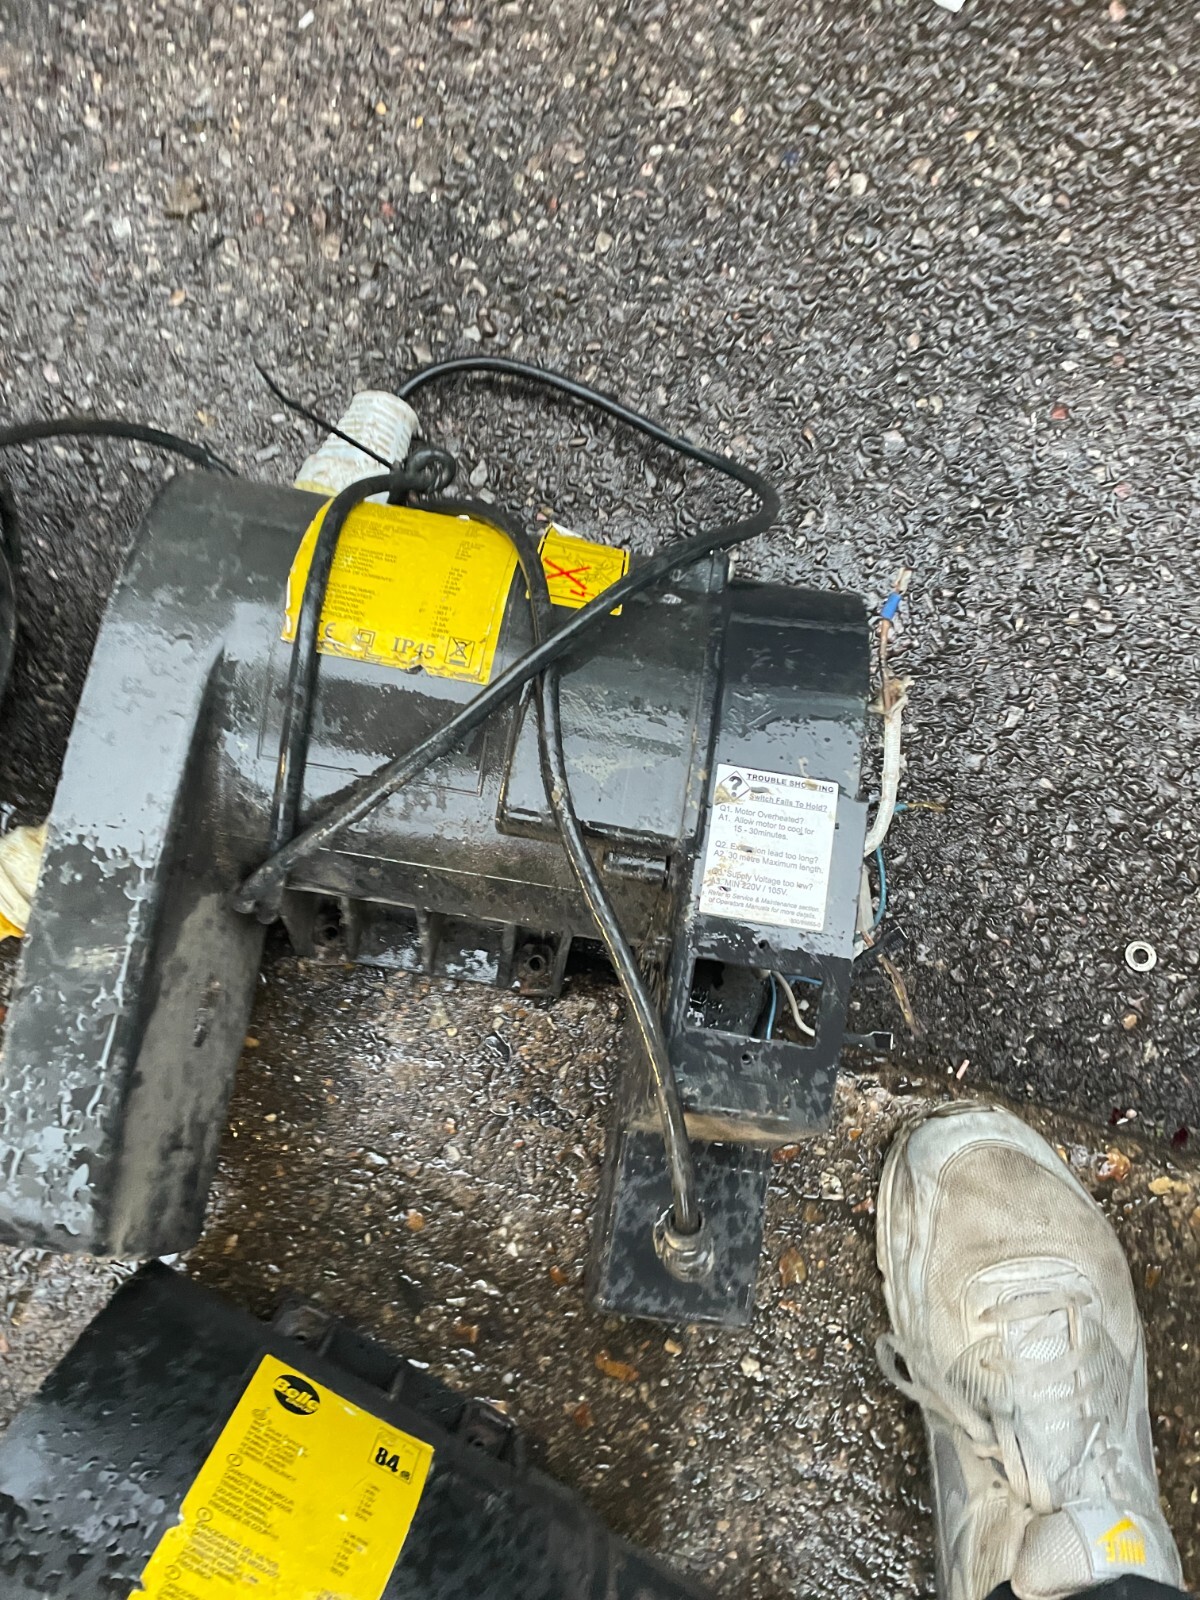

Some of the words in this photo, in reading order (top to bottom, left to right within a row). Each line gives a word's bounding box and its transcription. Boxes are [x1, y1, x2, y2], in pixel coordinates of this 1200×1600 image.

[391, 636, 436, 660] IP45
[746, 774, 786, 785] TROUBLE
[789, 780, 834, 793] SHOING
[749, 794, 773, 803] Switch
[806, 802, 827, 811] Hold?
[718, 814, 730, 822] A1.
[734, 816, 755, 825] Allow
[756, 821, 777, 829] motor
[787, 825, 803, 834] cool
[720, 805, 733, 813] Q1.
[735, 807, 756, 816] Motor
[757, 811, 804, 824] Overheated?
[749, 827, 788, 840] 30minutes.
[715, 840, 728, 849] Q2.
[768, 849, 784, 857] lead
[785, 852, 797, 860] too
[799, 854, 819, 864] long?
[739, 854, 760, 863] metre
[762, 857, 797, 869] Maximum
[799, 862, 823, 873] length.
[727, 869, 752, 881] Supply
[754, 874, 781, 886] Voltage
[725, 879, 740, 888] MIN
[741, 881, 761, 891] 220V
[768, 886, 788, 896] 105V.
[716, 898, 744, 907] Operators
[733, 892, 754, 901] Service
[761, 897, 798, 908] Maintenance
[375, 1447, 400, 1472] 84
